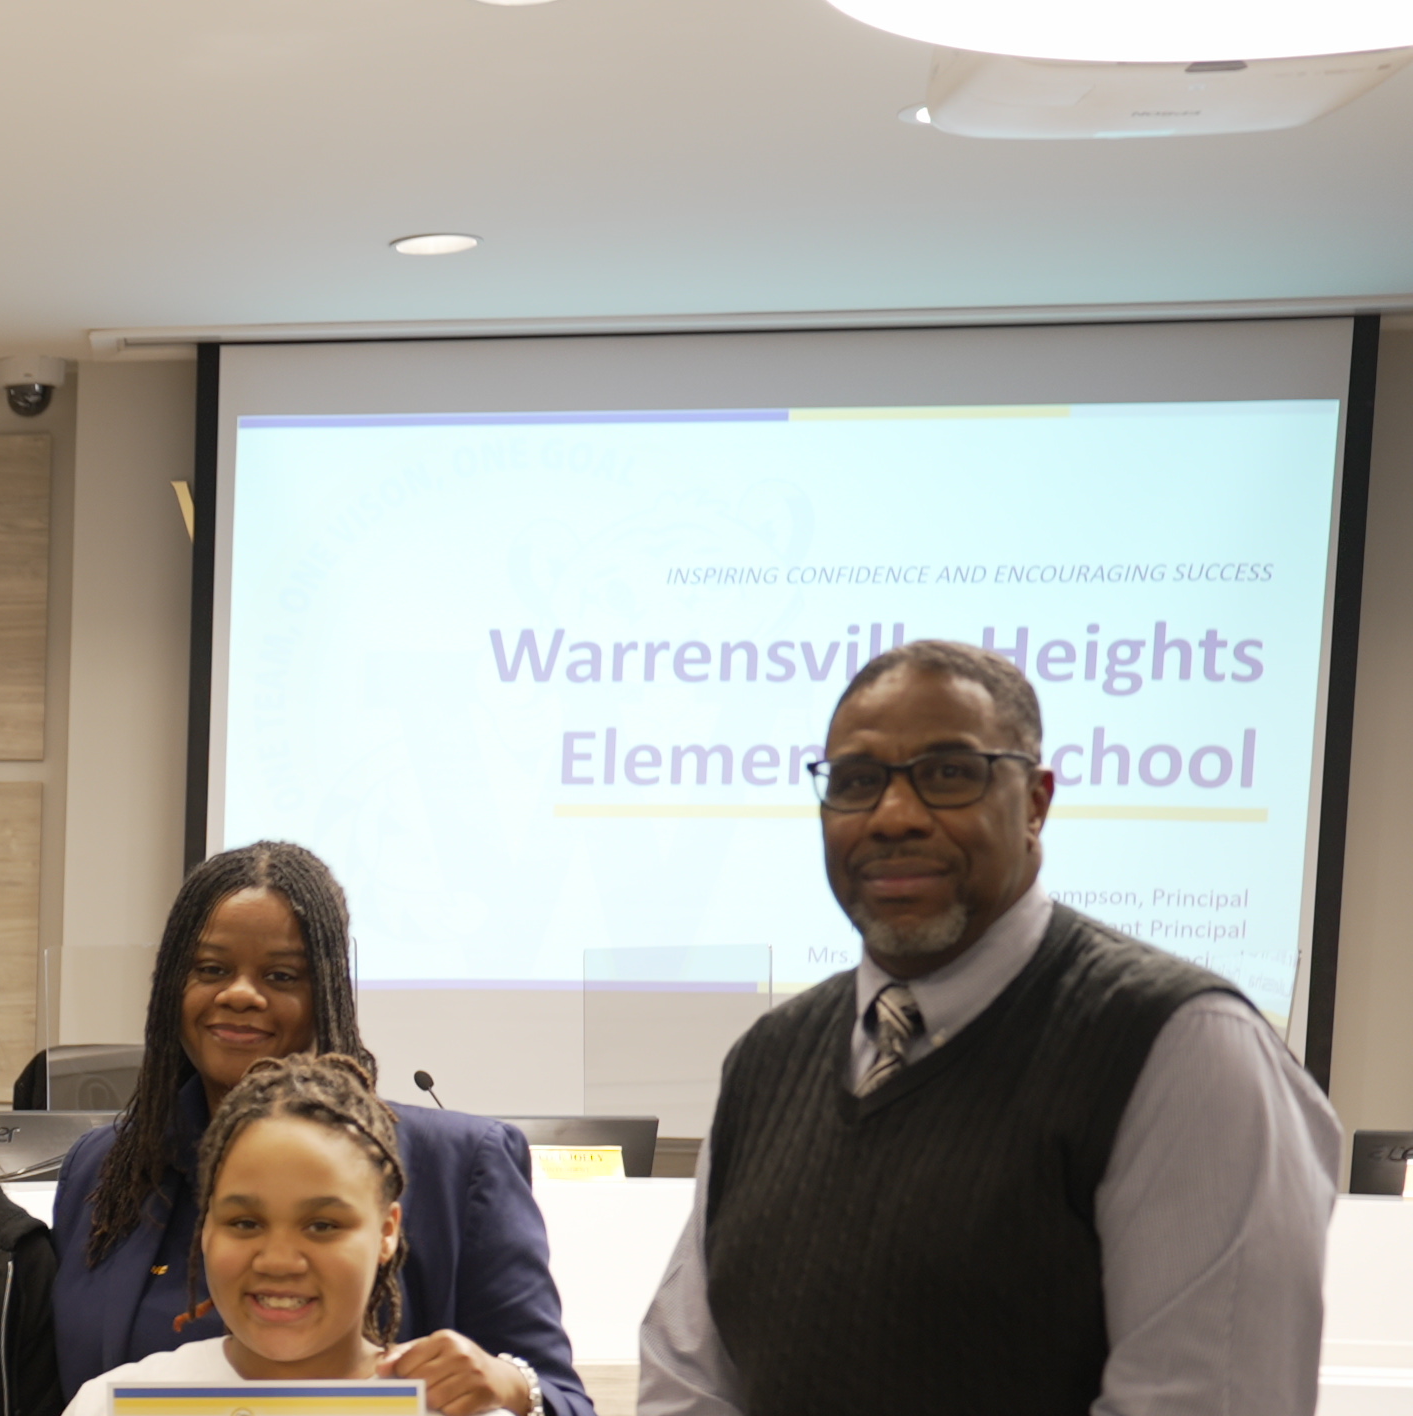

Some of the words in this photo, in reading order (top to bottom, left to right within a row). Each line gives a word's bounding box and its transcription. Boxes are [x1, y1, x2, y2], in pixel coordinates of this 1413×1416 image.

[666, 566, 778, 586] INSPIRING
[785, 565, 930, 585] CONFIDENCE
[935, 564, 987, 585] AND
[994, 563, 1167, 584] ENCOURAGING
[1173, 562, 1274, 583] SUCCESS
[489, 622, 905, 683] Warrensvil
[982, 621, 1265, 697] Heights
[561, 727, 827, 785] Elemen
[1053, 727, 1257, 789] chool
[1048, 890, 1143, 909] ompson,
[1152, 888, 1249, 911] Principal
[1150, 920, 1246, 942] Principal
[808, 946, 854, 964] Mrs.
